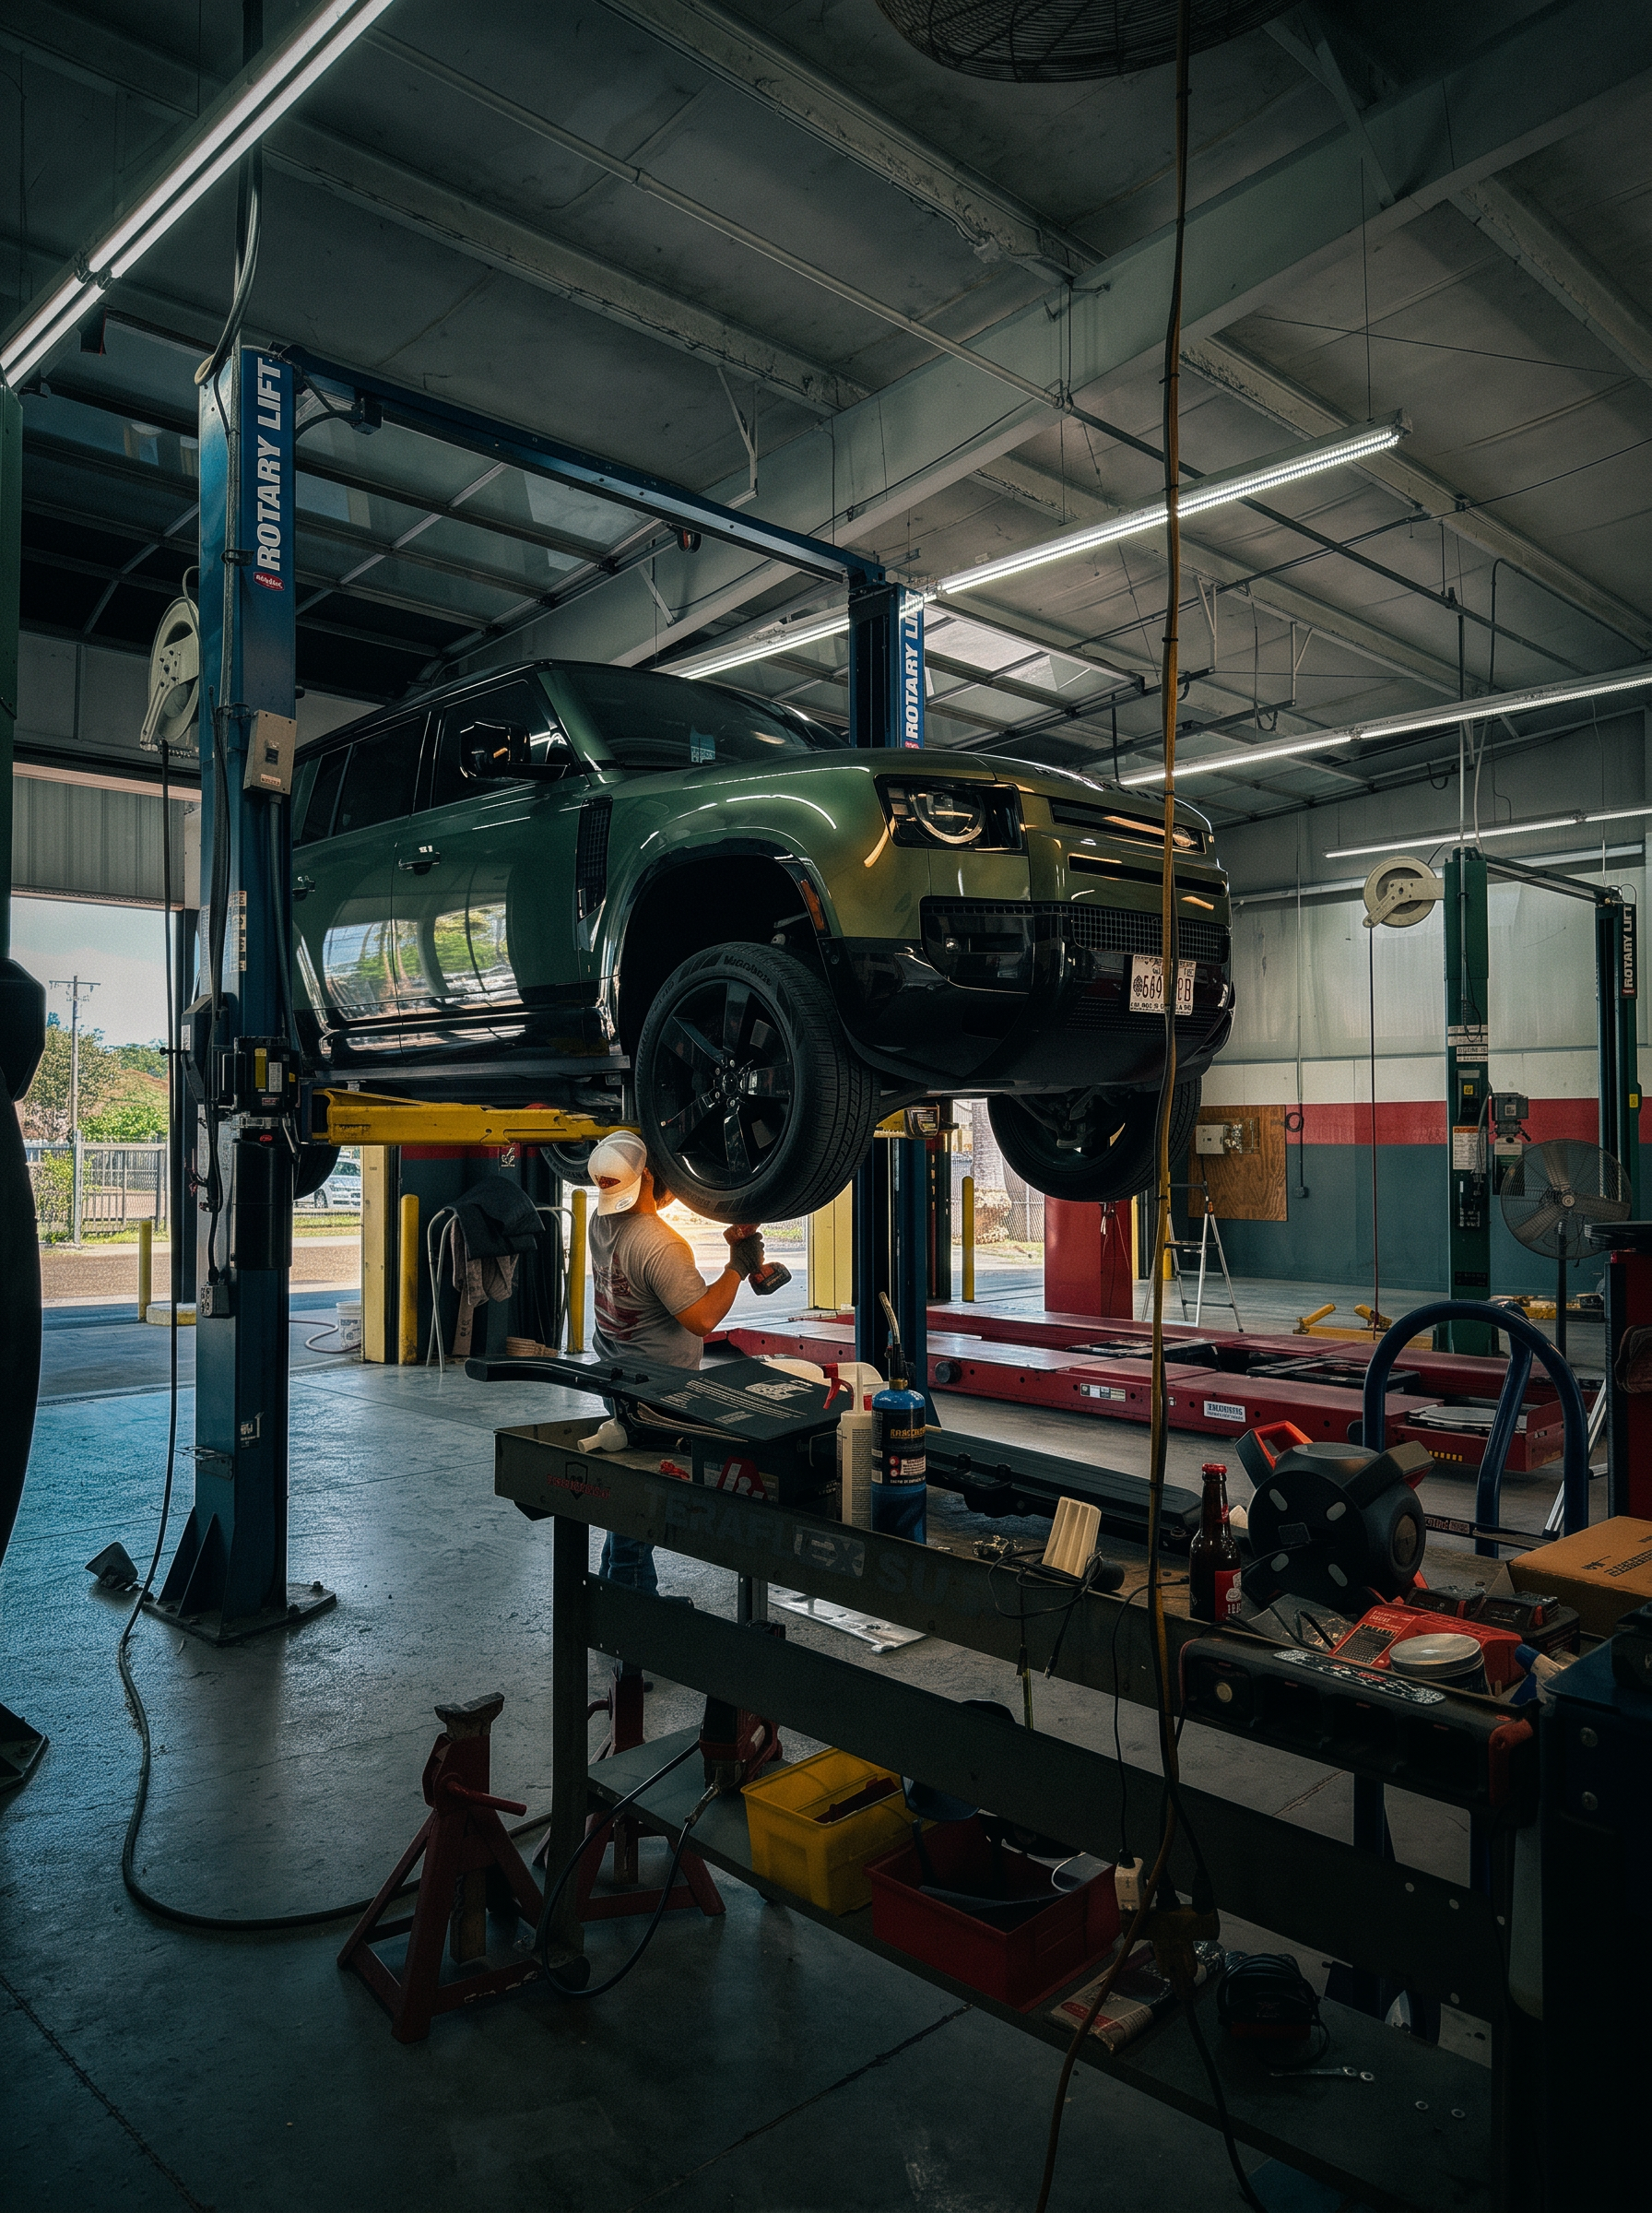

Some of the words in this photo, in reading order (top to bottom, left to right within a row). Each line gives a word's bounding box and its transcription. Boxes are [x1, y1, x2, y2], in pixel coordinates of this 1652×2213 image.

[257, 357, 281, 431] LIFT
[257, 434, 281, 572] ROTARY
[904, 642, 919, 740] ROTARY
[1622, 934, 1634, 988] ROTARY
[643, 1481, 865, 1580] TERAFLEX
